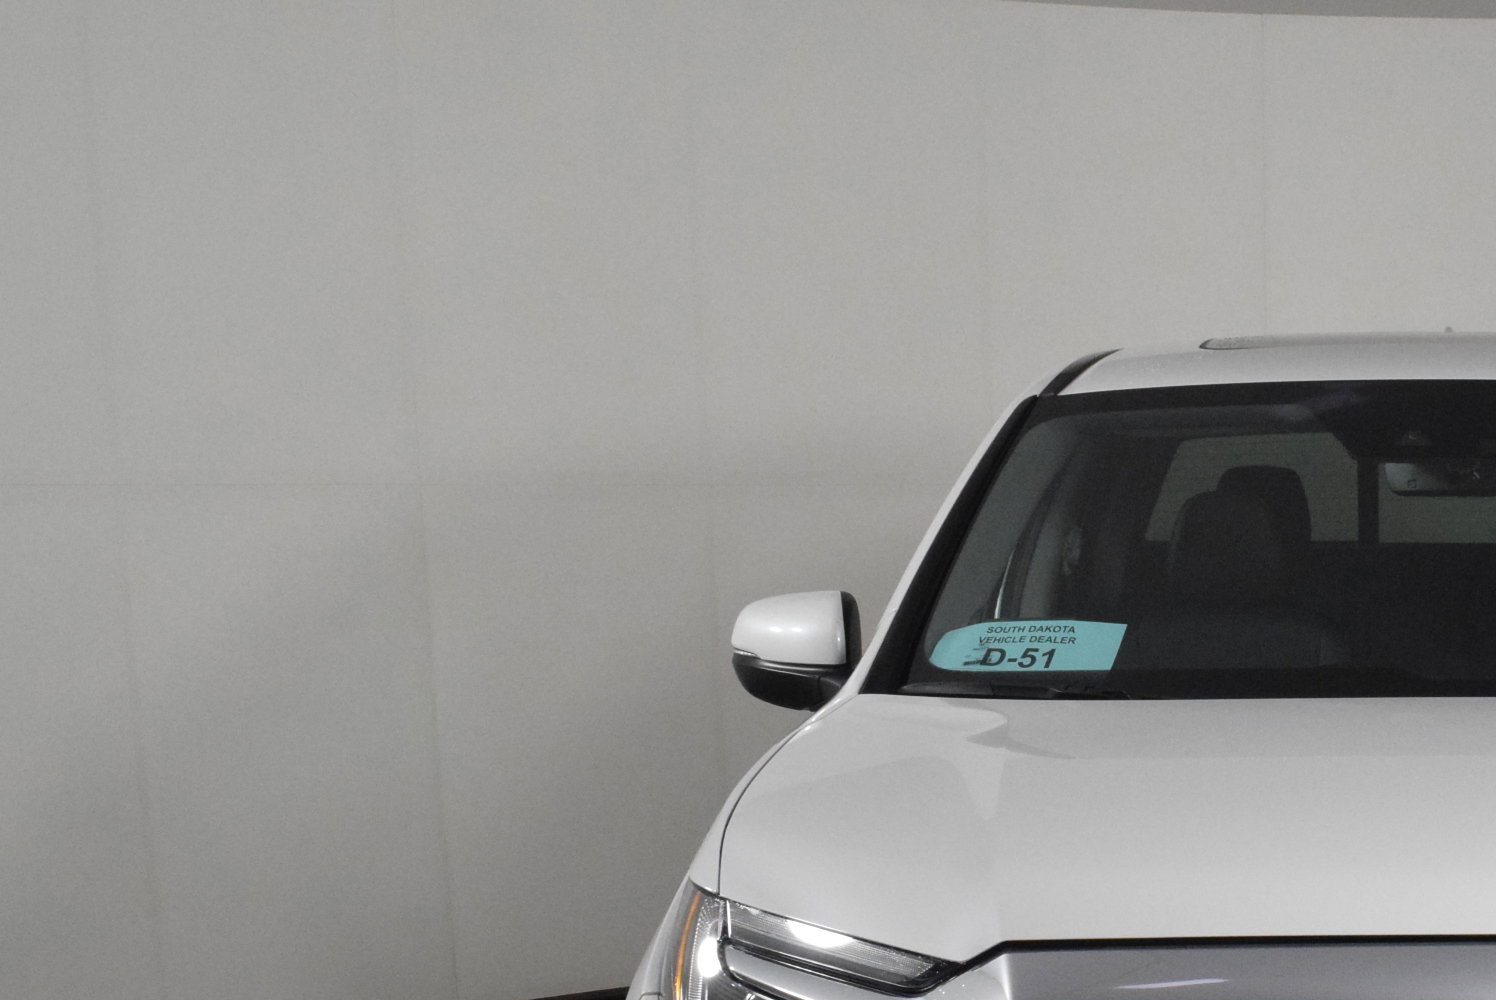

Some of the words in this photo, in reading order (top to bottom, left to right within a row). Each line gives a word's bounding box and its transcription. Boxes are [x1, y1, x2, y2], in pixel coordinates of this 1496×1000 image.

[986, 626, 1026, 634] SOUTH
[1028, 625, 1076, 634] DAKOTA
[979, 636, 1027, 644] VEHICLE
[1029, 635, 1077, 645] DEALER
[980, 647, 1057, 669] D-51
